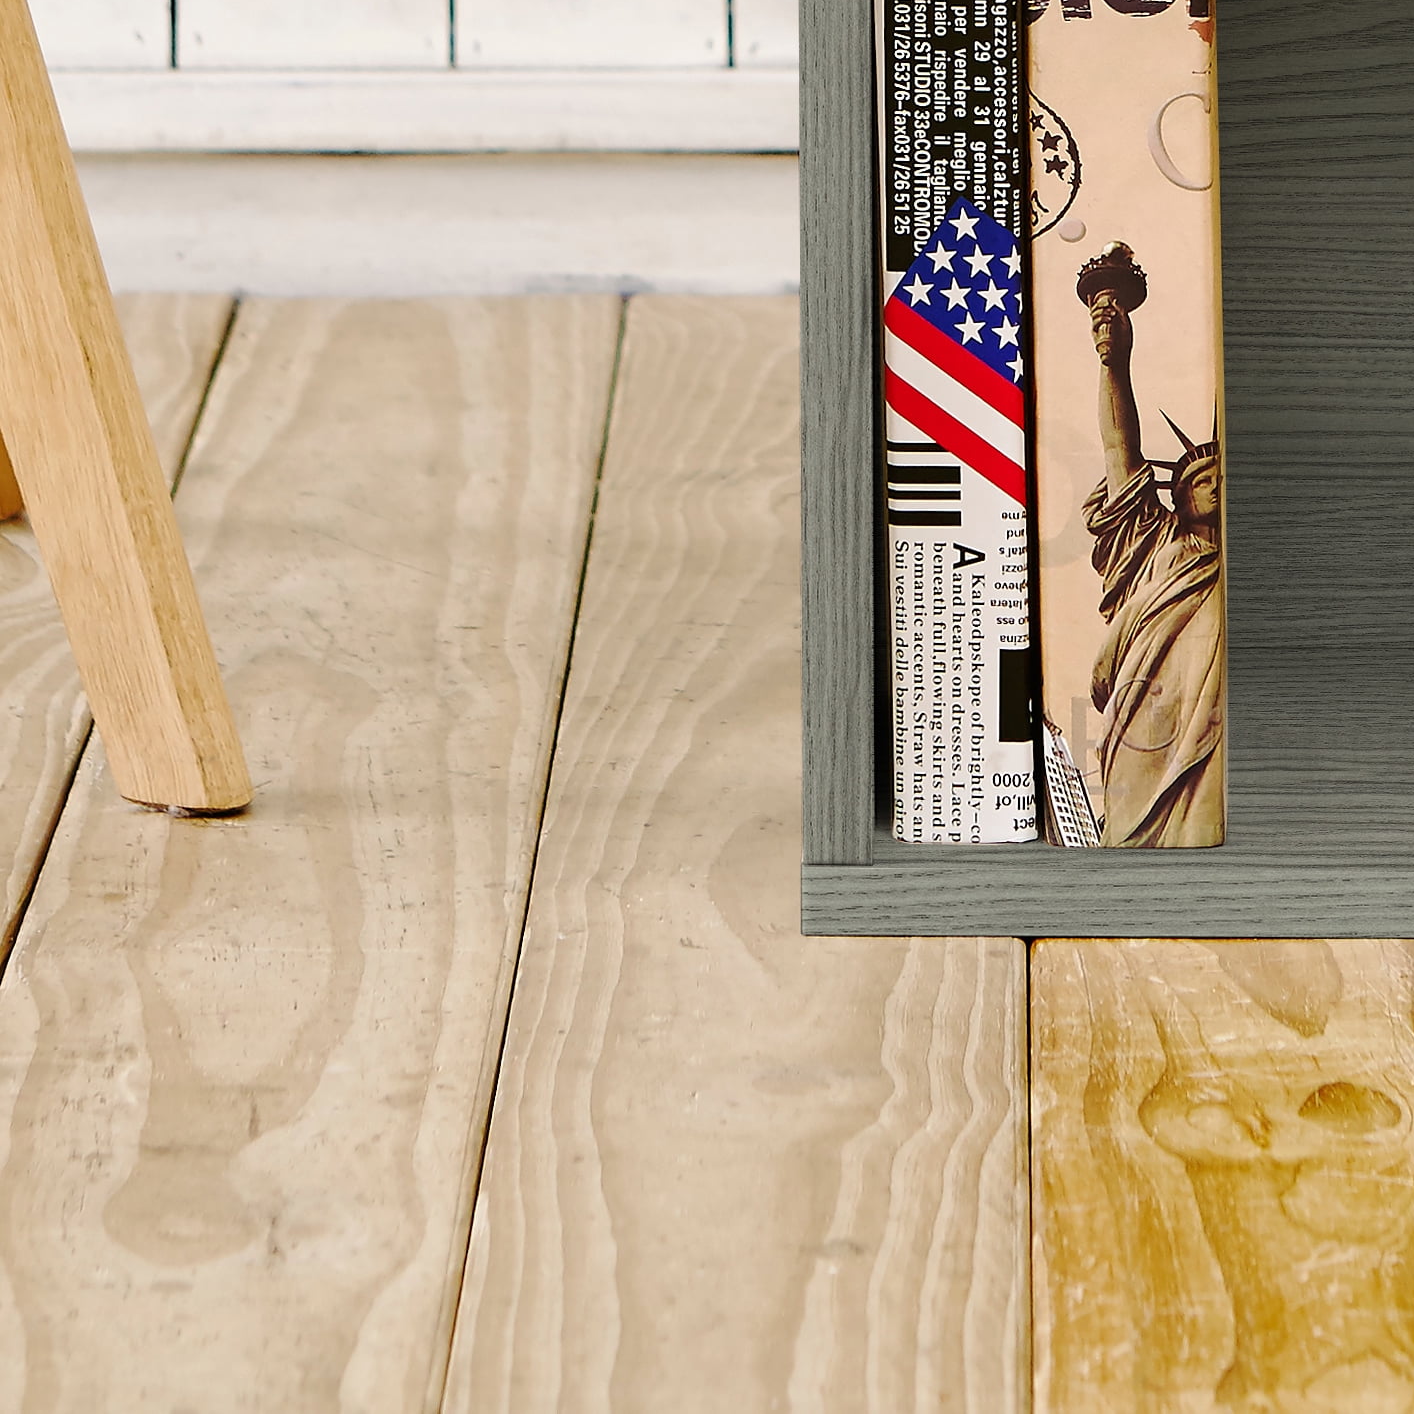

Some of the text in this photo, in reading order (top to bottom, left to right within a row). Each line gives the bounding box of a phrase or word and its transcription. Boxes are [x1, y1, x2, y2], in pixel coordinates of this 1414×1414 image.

[950, 6, 967, 34] per
[974, 40, 990, 62] 29
[914, 41, 931, 106] STUDIO
[931, 50, 950, 122] rispedire
[954, 48, 970, 117] vendere
[974, 76, 990, 91] al
[974, 106, 990, 125] 31
[933, 135, 950, 145] il
[950, 132, 969, 191] meglio
[894, 193, 910, 212] 51
[894, 215, 910, 235] 25
[895, 540, 909, 569] Sui
[952, 542, 986, 570] A
[914, 542, 927, 626] romantic
[933, 542, 946, 615] beneath
[952, 573, 965, 606] and
[895, 576, 907, 631] vestiti
[895, 637, 908, 681] delle
[952, 613, 965, 671] hearts
[966, 574, 985, 707] Kaleodpskope
[912, 632, 926, 707] accents,
[929, 621, 946, 730] full,flowing
[952, 676, 963, 698] on
[896, 687, 908, 765] bambine
[913, 712, 927, 767] Straw
[951, 704, 965, 777] dresses.
[971, 712, 985, 730] of
[896, 771, 904, 793] un
[932, 735, 945, 789] skirts
[914, 773, 926, 811] hats
[932, 794, 945, 827] and
[951, 783, 965, 826] Lace
